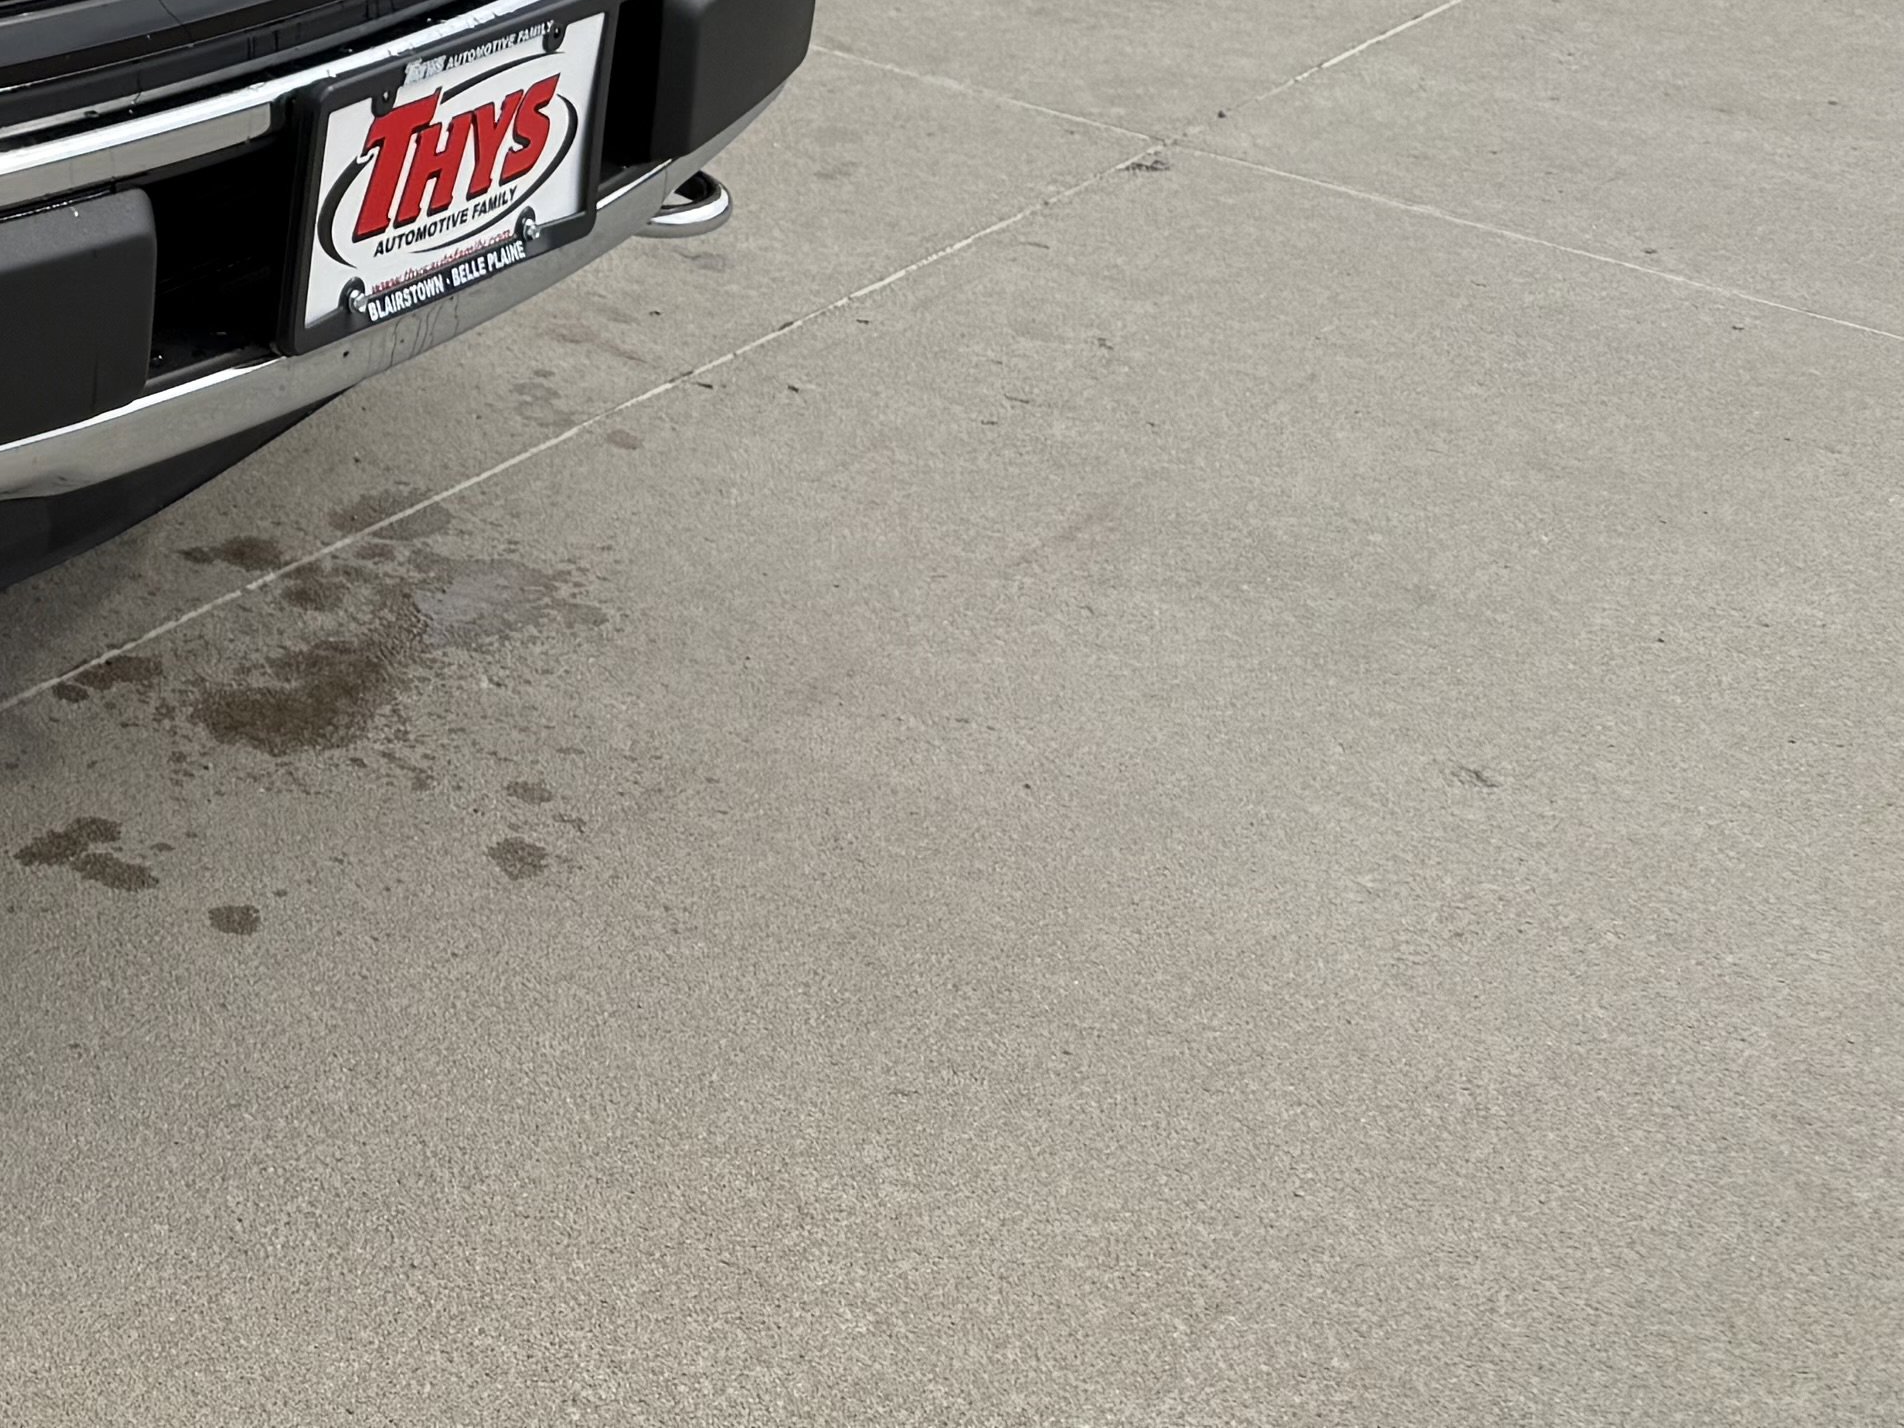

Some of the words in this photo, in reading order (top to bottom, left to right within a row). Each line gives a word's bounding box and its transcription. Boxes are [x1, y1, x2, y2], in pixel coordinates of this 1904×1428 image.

[446, 33, 516, 70] AUTOMOTIVE
[517, 20, 554, 44] FAMILY
[352, 72, 561, 243] THYS
[373, 212, 469, 257] AUTOMOTIVE
[471, 186, 519, 220] FAMILY
[367, 274, 445, 322] BLAIRSTOWN
[451, 254, 487, 287] BELLE
[488, 240, 526, 272] PLAINE
